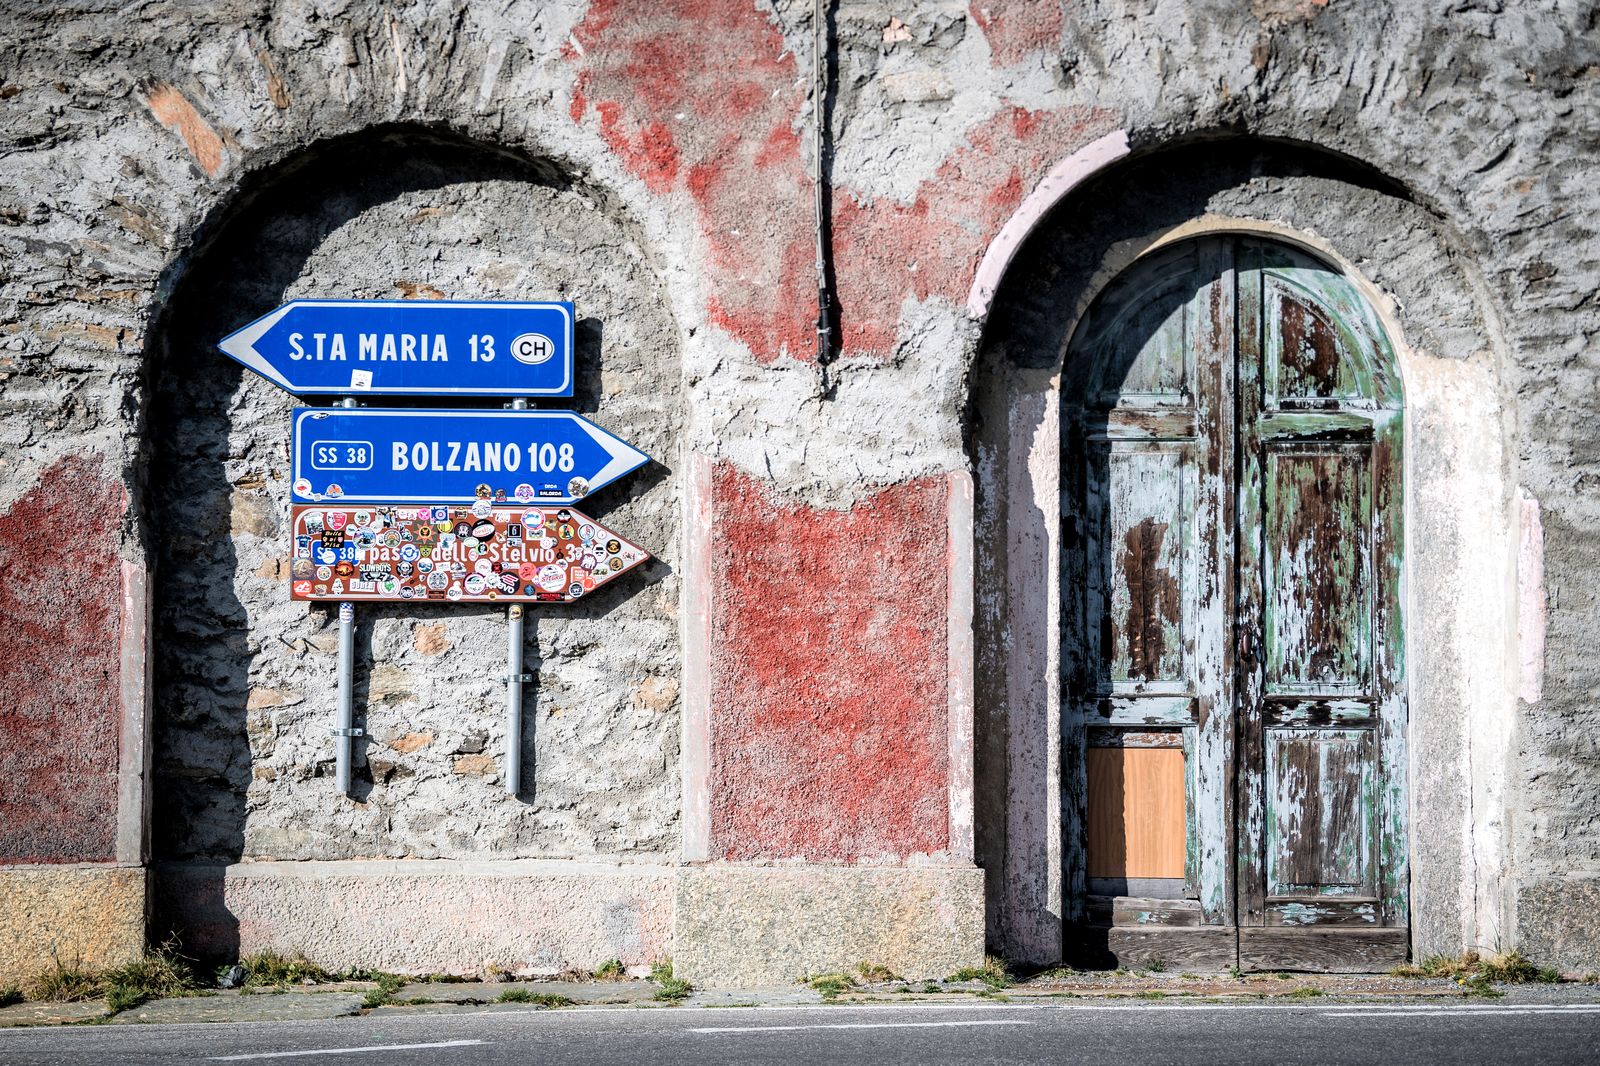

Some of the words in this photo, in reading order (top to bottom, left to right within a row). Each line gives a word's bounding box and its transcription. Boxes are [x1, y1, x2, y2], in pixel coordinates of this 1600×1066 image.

[288, 332, 347, 361] S.TA
[358, 333, 448, 361] MARIA
[468, 334, 496, 362] 13
[520, 341, 546, 356] CH
[318, 447, 338, 464] SS
[346, 447, 367, 464] 38
[391, 441, 521, 472] BOLZANO
[527, 442, 575, 473] 108
[339, 547, 354, 560] 38
[369, 547, 414, 564] pas
[431, 542, 478, 562] dell
[489, 542, 555, 563] Stelvio
